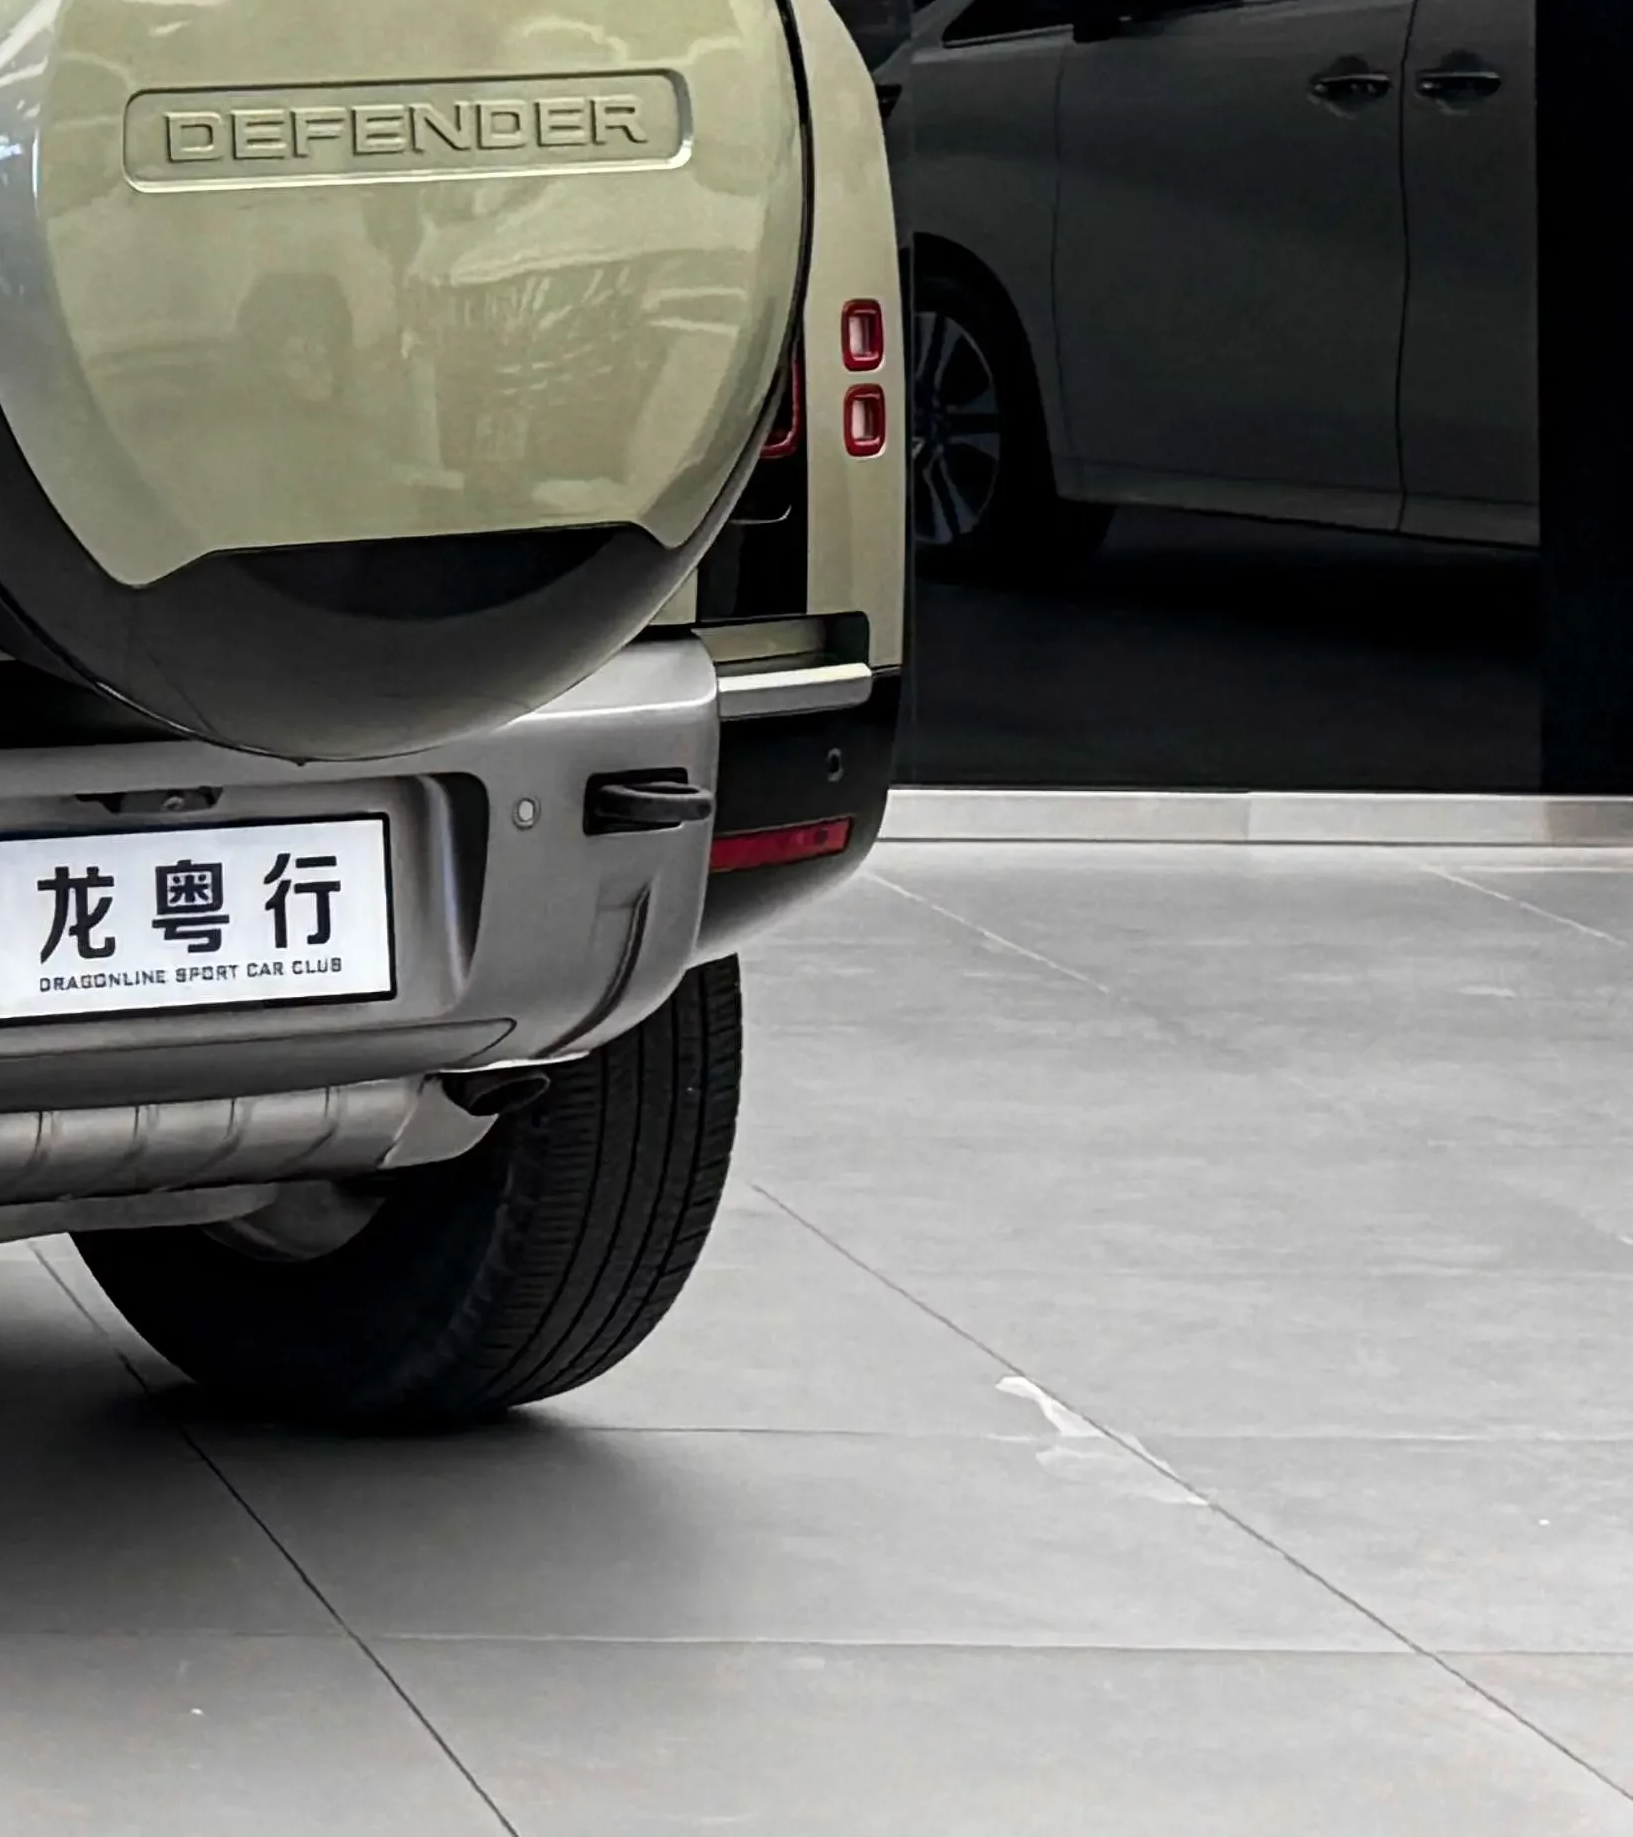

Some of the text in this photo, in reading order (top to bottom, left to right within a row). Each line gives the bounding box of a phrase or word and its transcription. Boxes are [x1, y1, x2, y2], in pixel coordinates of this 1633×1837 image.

[163, 94, 649, 163] DEFENDER
[37, 852, 342, 964] 龙粤行
[39, 956, 343, 993] DRAGONLINE SPORT CAR CLUB
